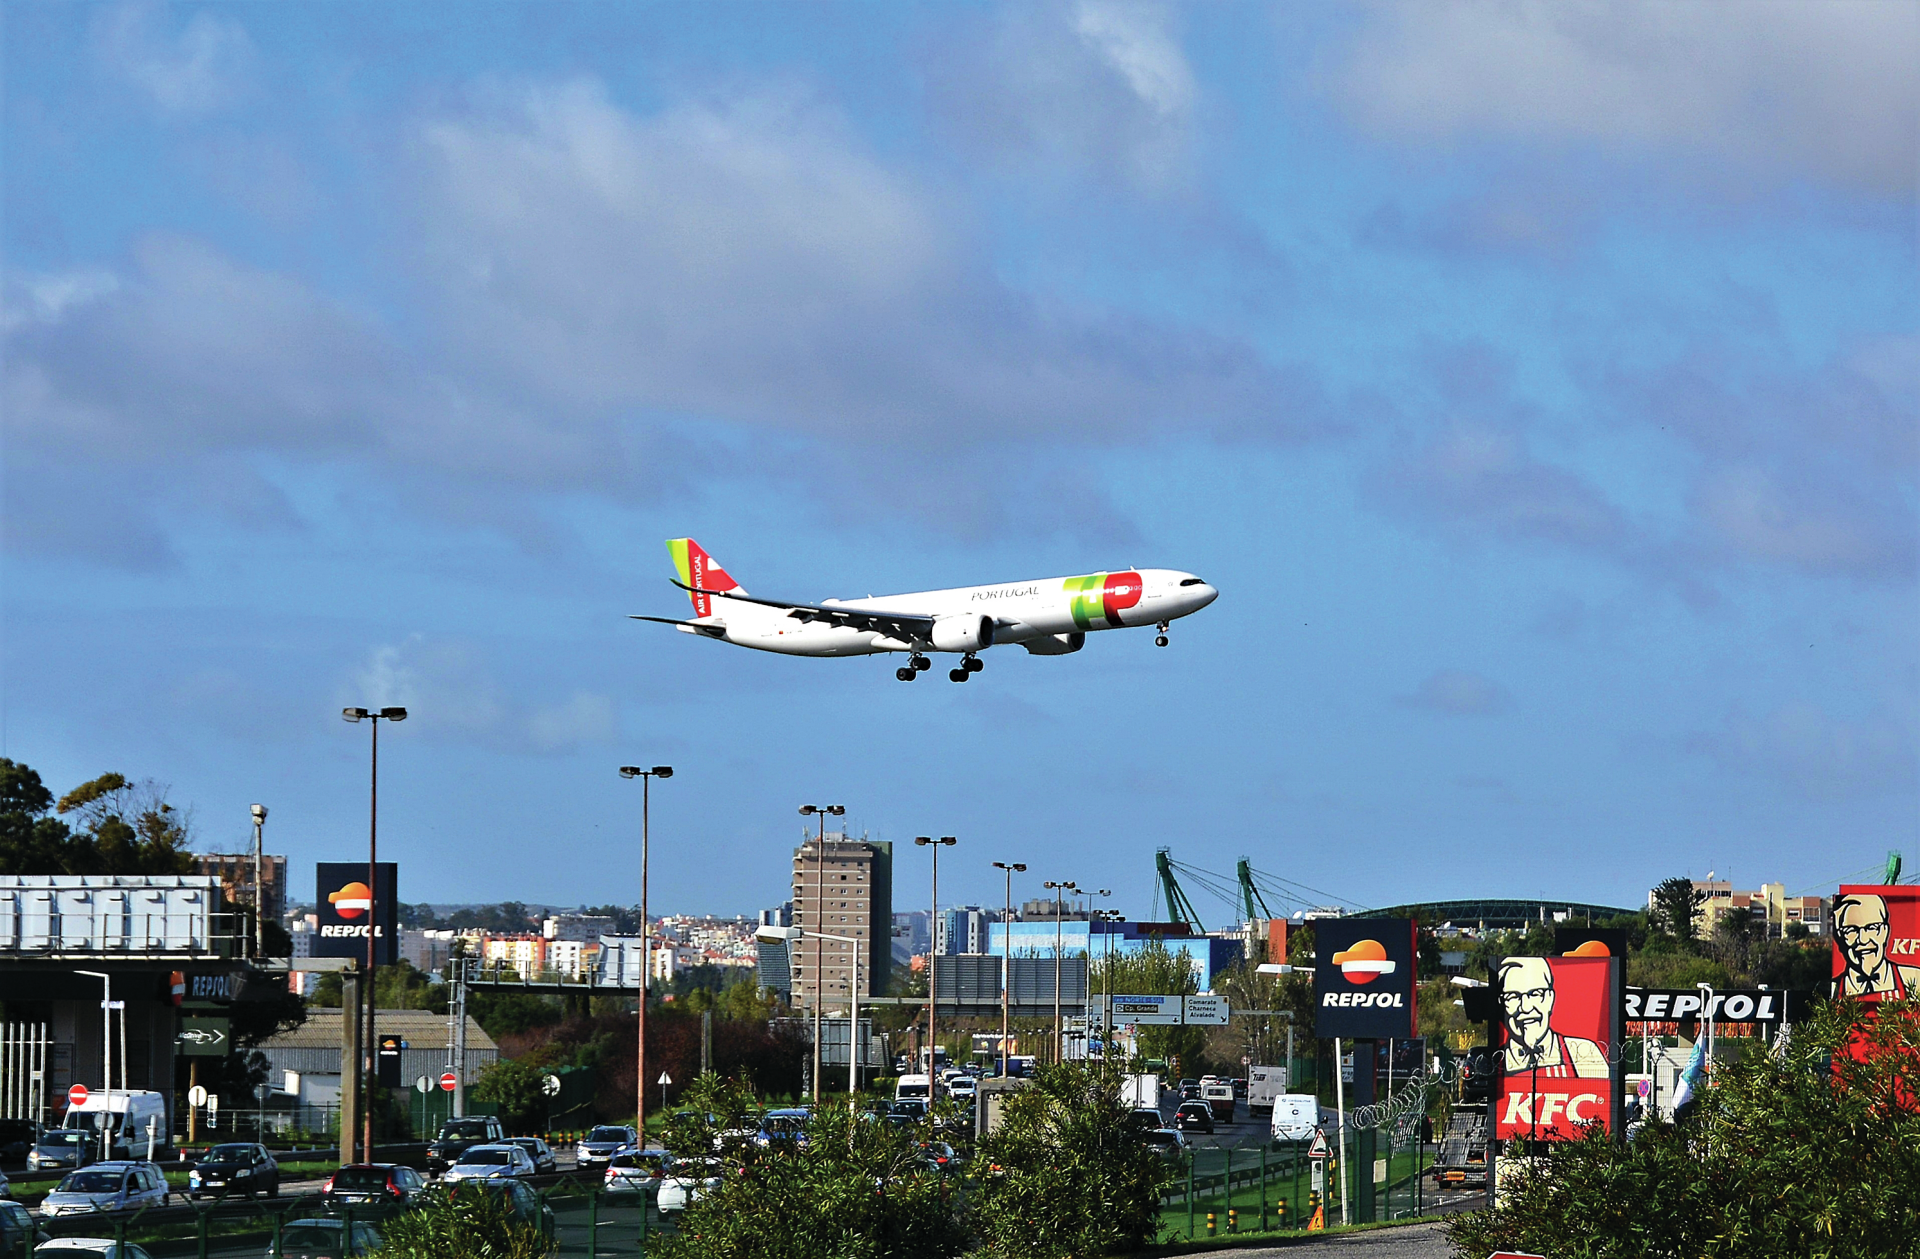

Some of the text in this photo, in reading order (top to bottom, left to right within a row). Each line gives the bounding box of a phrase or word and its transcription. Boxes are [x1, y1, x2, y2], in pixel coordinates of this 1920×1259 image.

[971, 586, 1040, 602] PORTUGAL
[697, 598, 706, 614] AIR
[320, 924, 383, 938] REPSOL
[192, 975, 231, 998] REPSOL
[1322, 992, 1404, 1008] REPSOL
[1501, 1092, 1598, 1127] KFC
